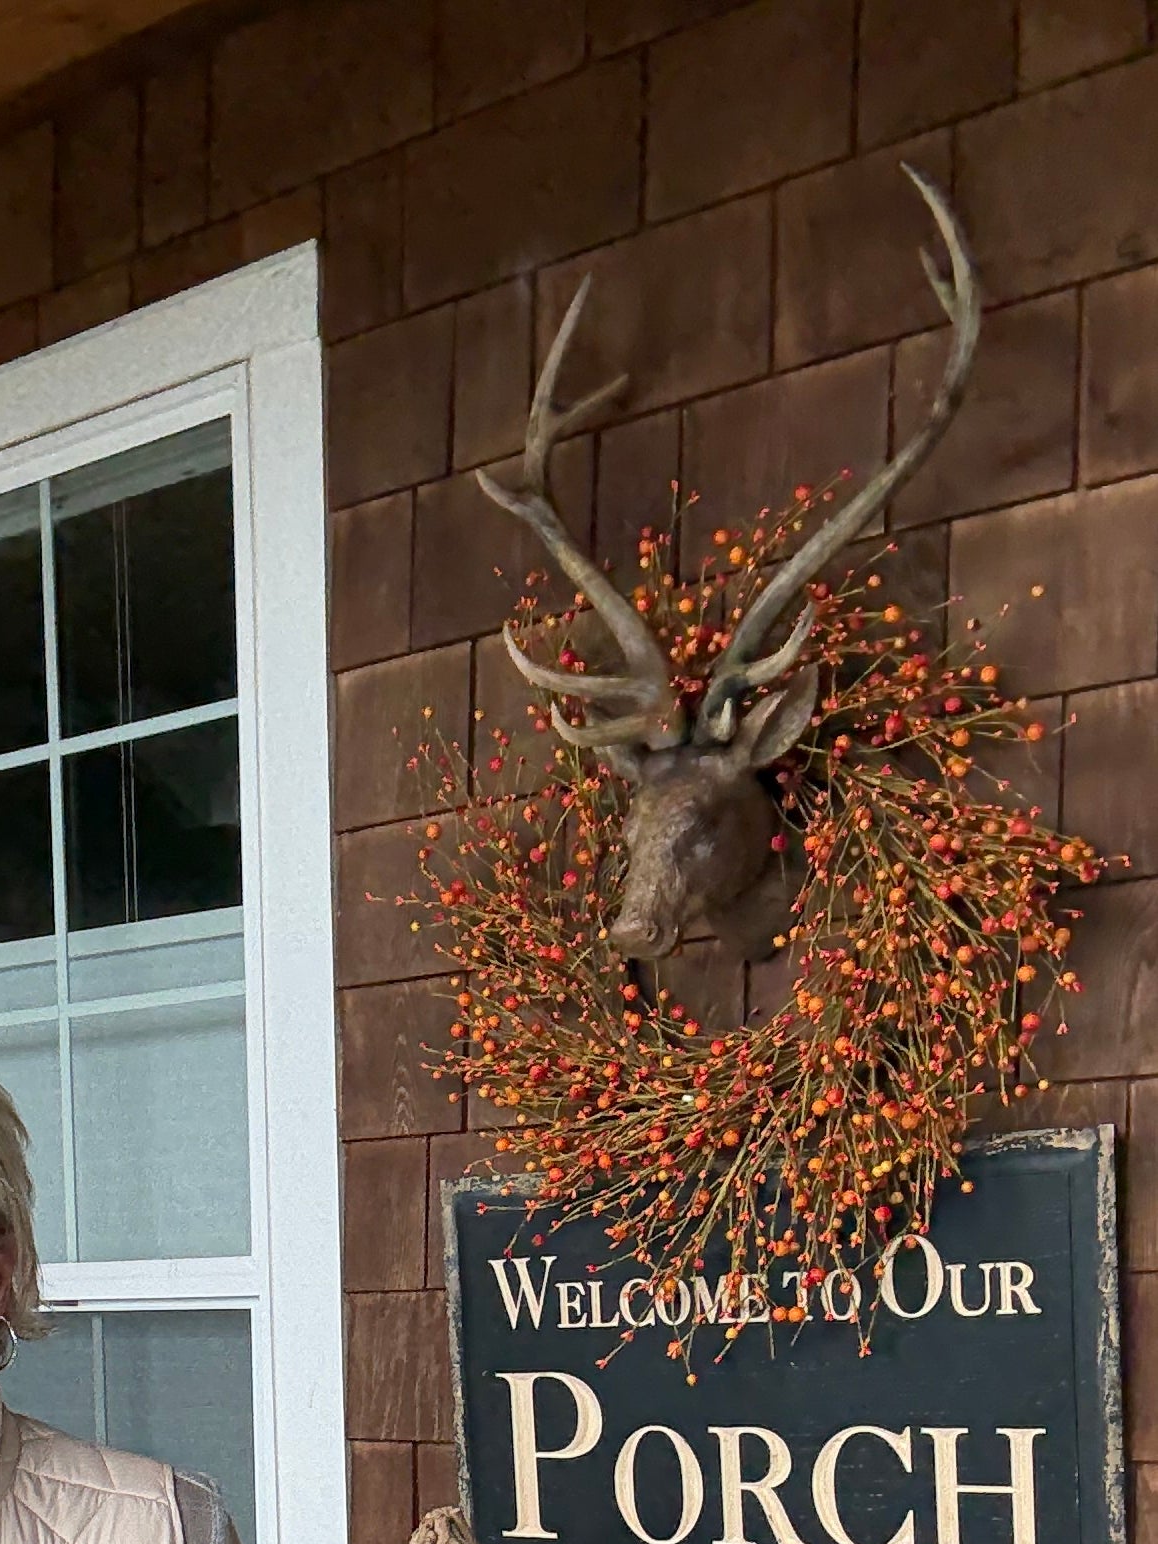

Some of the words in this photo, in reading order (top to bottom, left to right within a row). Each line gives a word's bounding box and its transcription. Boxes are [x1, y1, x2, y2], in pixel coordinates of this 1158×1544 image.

[487, 1255, 770, 1330] WELCOME
[782, 1268, 862, 1321] TO
[880, 1233, 1042, 1319] OUR
